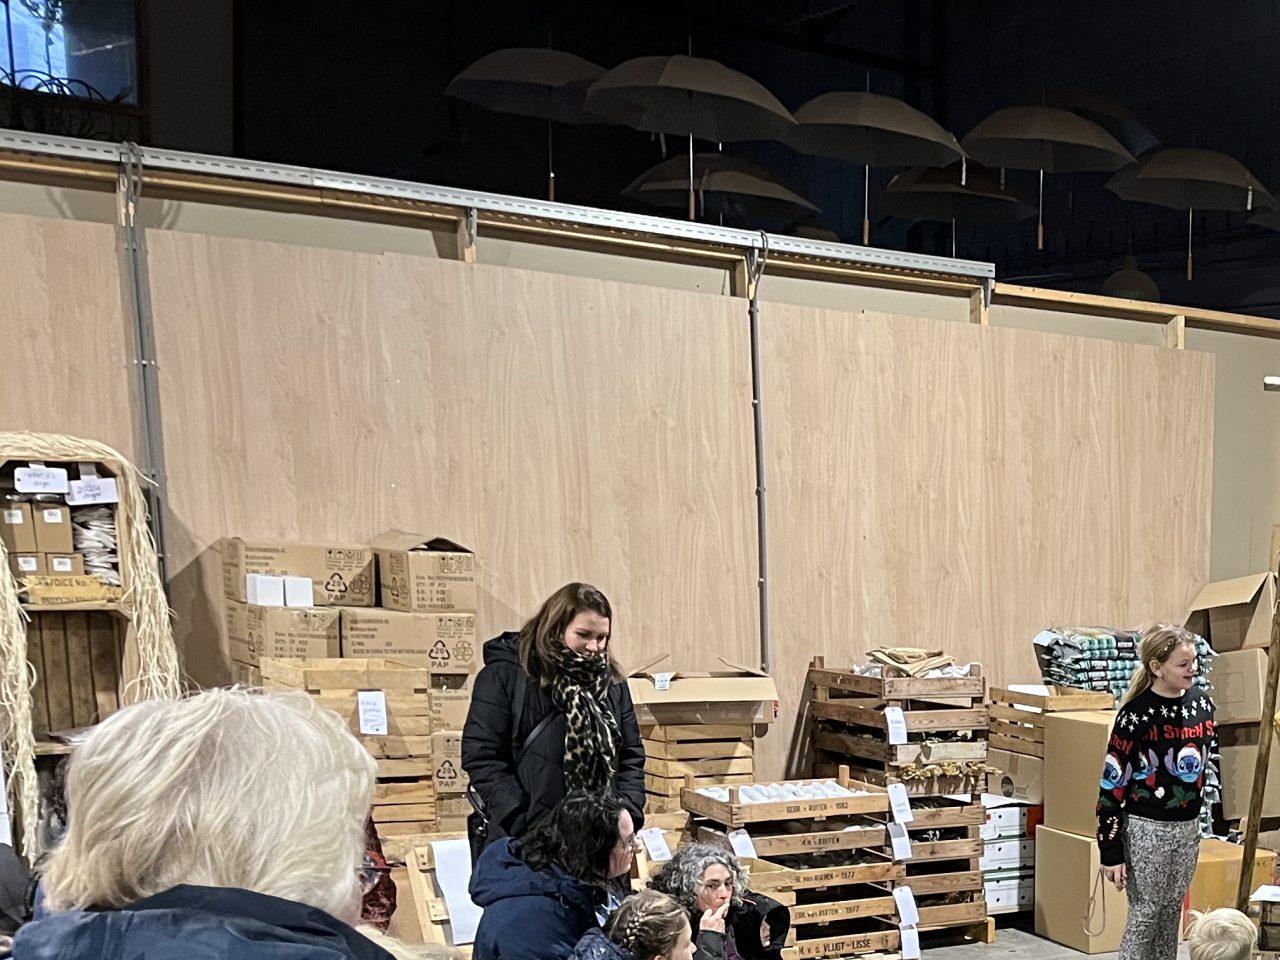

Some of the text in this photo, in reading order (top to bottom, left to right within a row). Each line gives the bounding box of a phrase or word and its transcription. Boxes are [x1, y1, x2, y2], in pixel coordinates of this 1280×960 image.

[327, 592, 346, 601] PAP
[431, 661, 449, 669] PAP
[438, 780, 456, 788] PAP
[841, 871, 855, 879] 1977
[853, 938, 872, 950] LISSE
